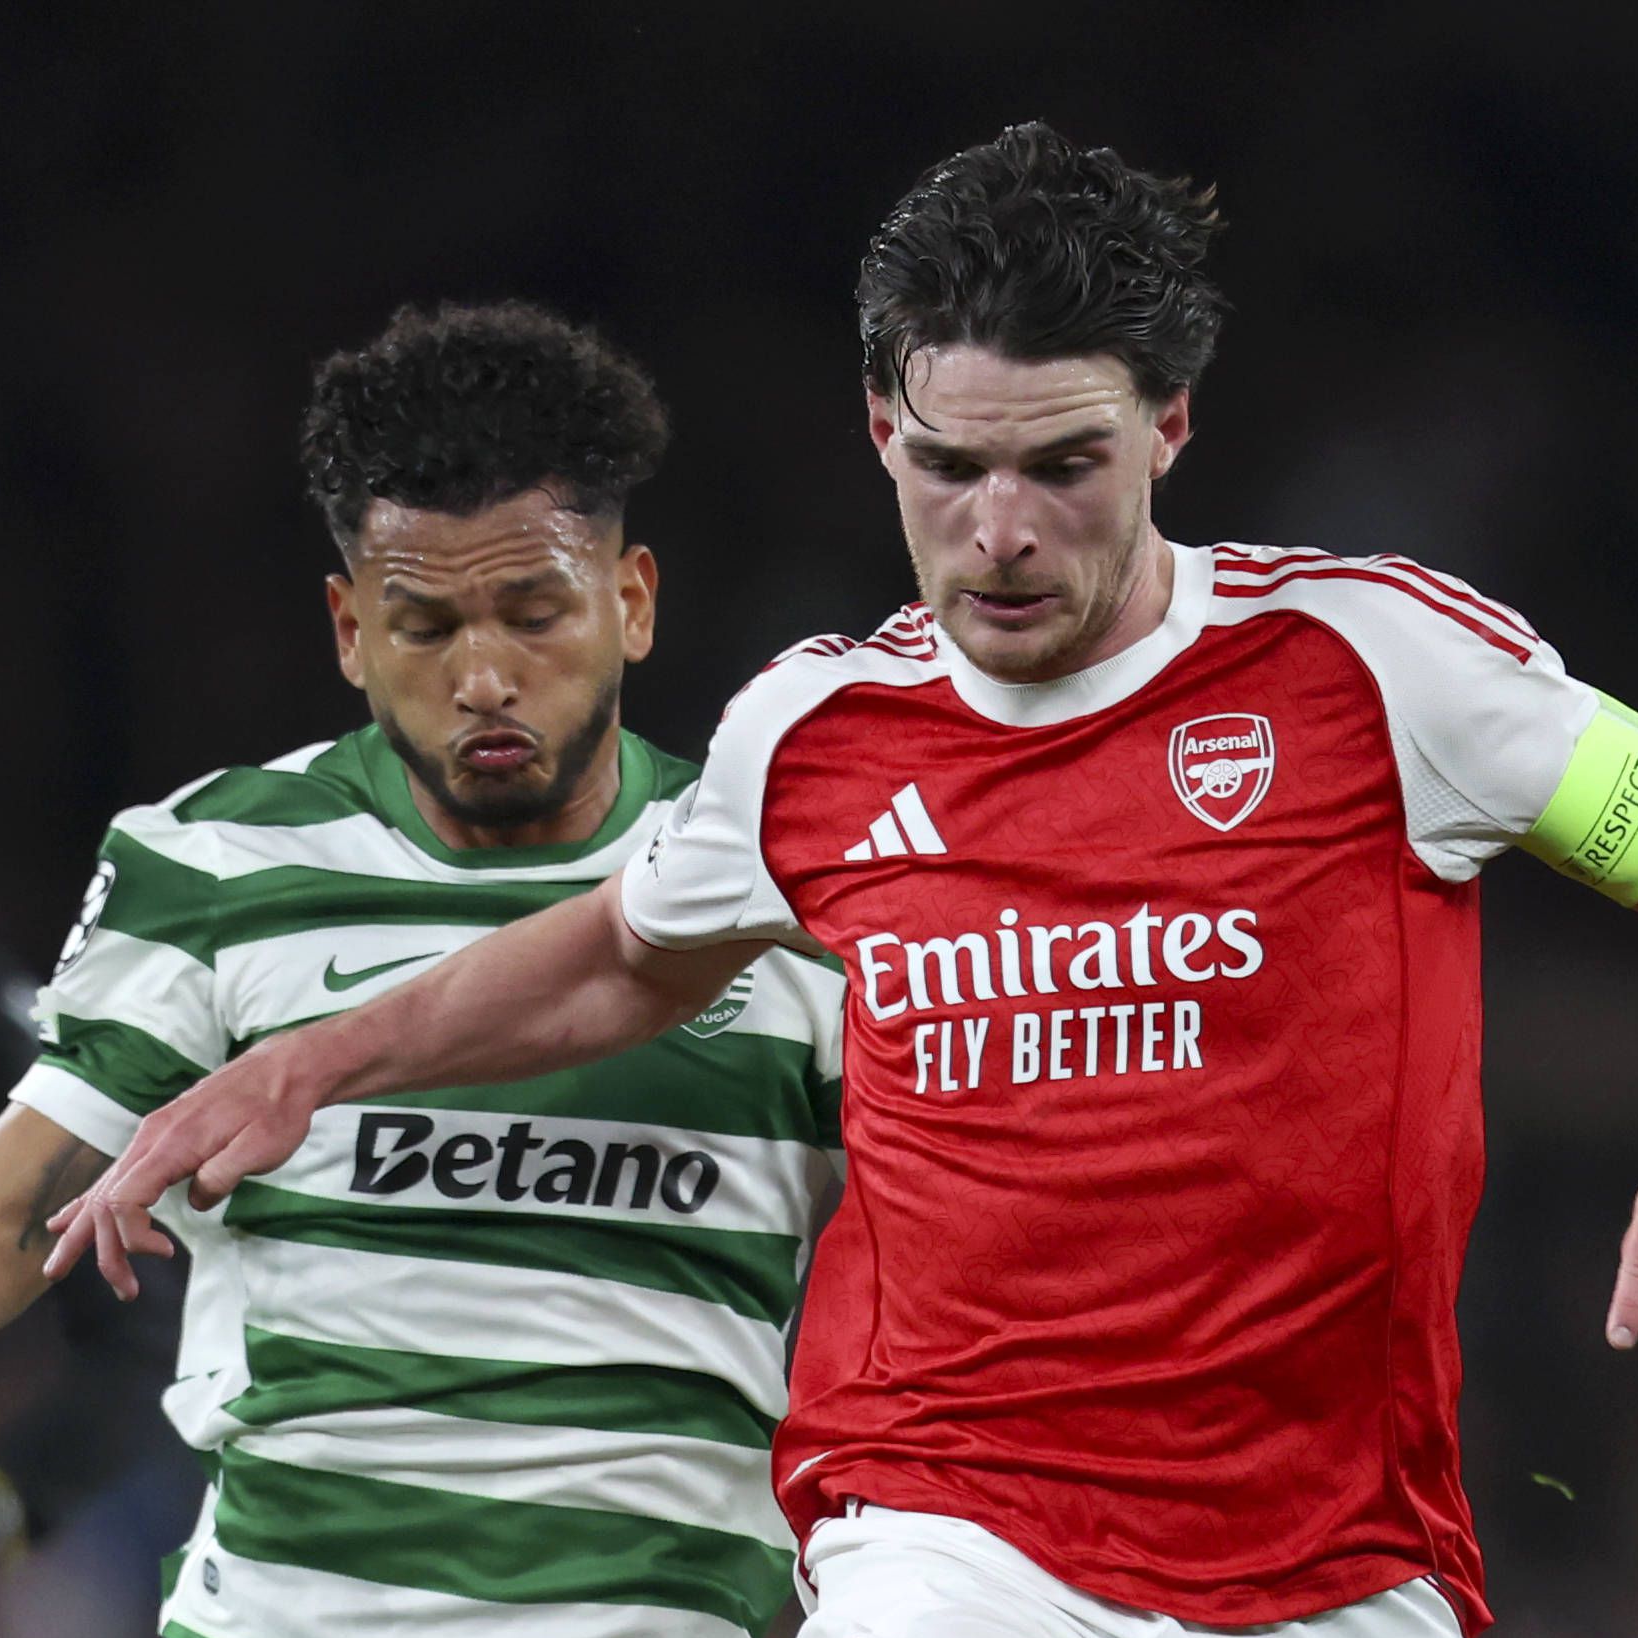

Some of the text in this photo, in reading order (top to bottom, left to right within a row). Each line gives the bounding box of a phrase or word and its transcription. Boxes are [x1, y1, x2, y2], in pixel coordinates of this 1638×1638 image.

[1184, 731, 1259, 756] Arsenal
[856, 902, 1264, 1022] Emirates
[914, 1000, 1203, 1095] FLY BETTER
[349, 1112, 721, 1215] Betano
